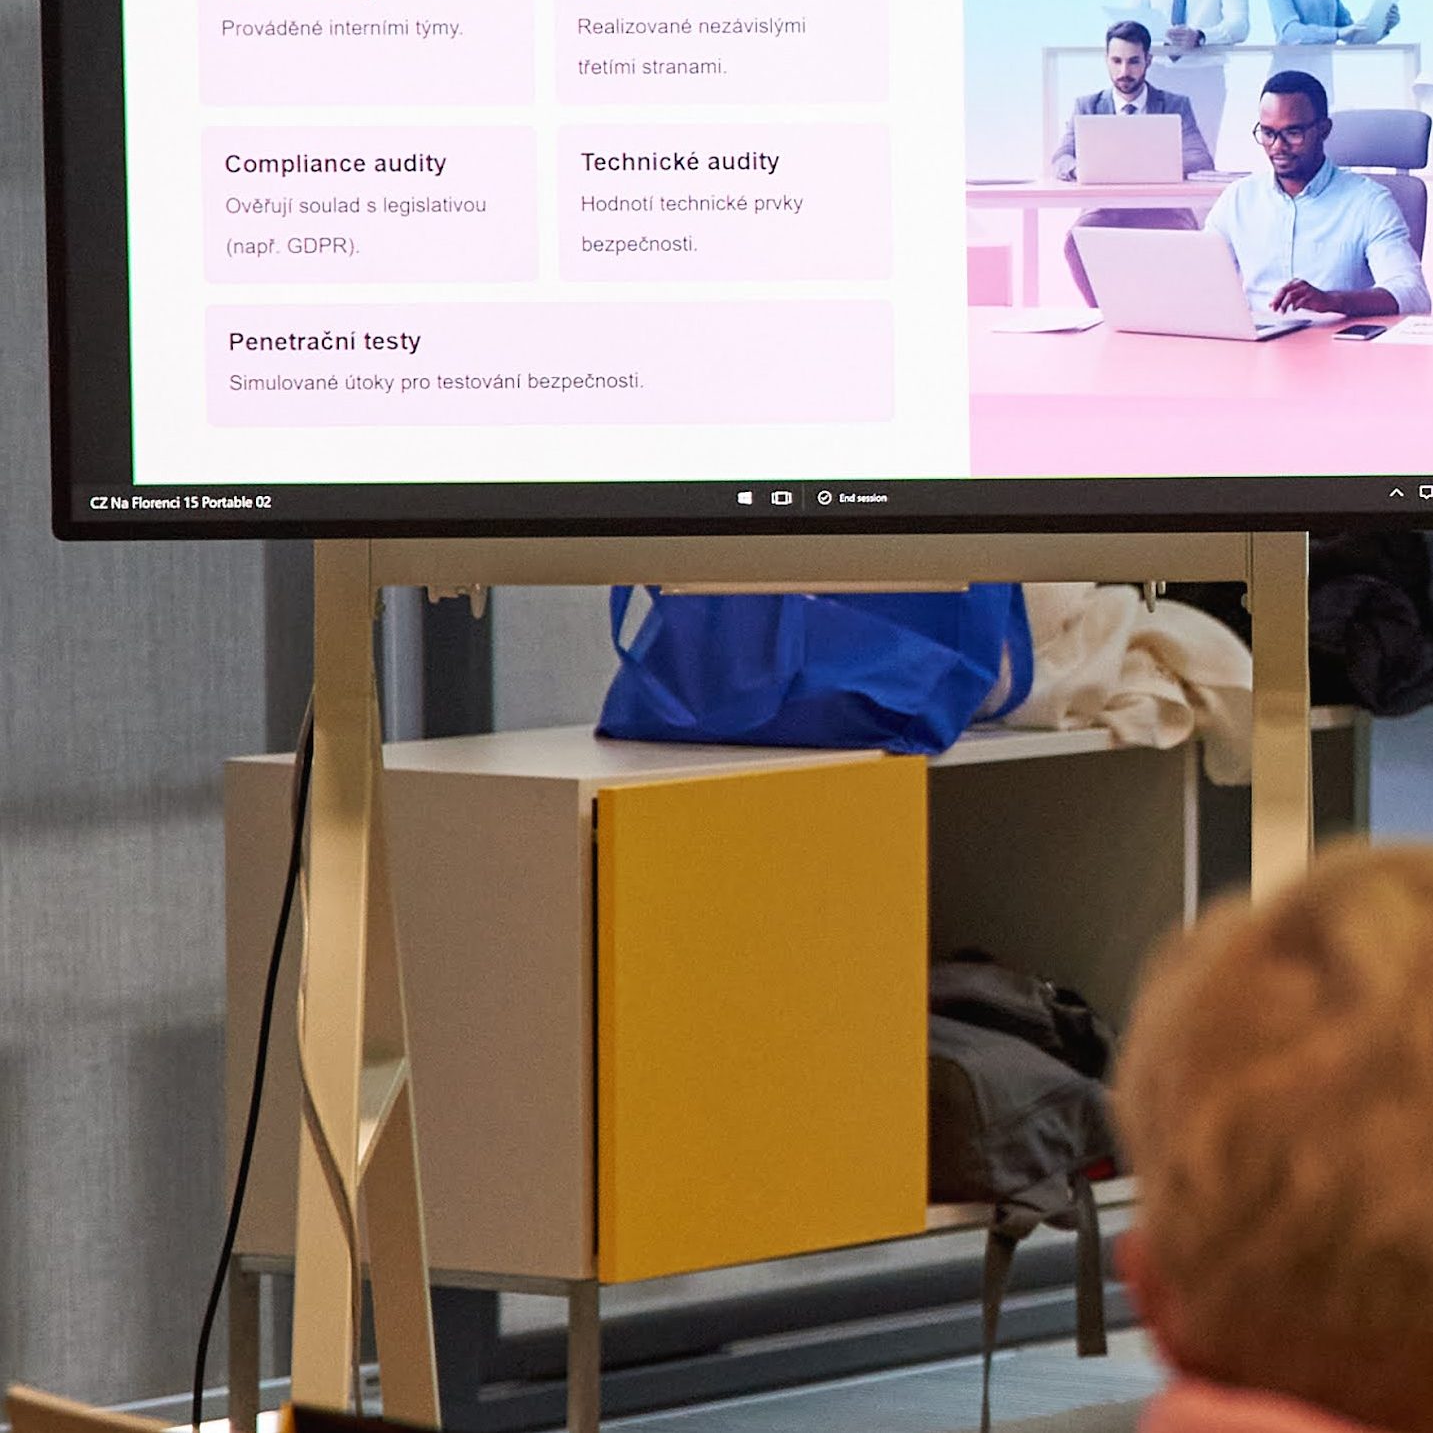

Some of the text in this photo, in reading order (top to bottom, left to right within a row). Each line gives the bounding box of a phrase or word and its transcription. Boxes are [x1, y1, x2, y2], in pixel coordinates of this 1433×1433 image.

[222, 19, 464, 40] Prováděné interními týmy.
[578, 17, 806, 38] Realizované nezávislými
[578, 59, 726, 75] třetími stranami.
[225, 153, 447, 178] Compliance audity
[580, 151, 780, 175] Technické audity
[225, 196, 486, 218] Ověřují soulad s legislativou
[581, 194, 803, 215] Hodnotí technické prvky
[226, 237, 359, 258] (např. GDPR).
[582, 235, 696, 256] bezpečnosti.
[229, 330, 421, 355] Penetrační testy
[229, 372, 643, 394] Simulované útoky pro testování bezpečnosti.
[89, 495, 272, 510] CZ Na Florenci 15 Portable 02
[839, 492, 888, 503] End session
